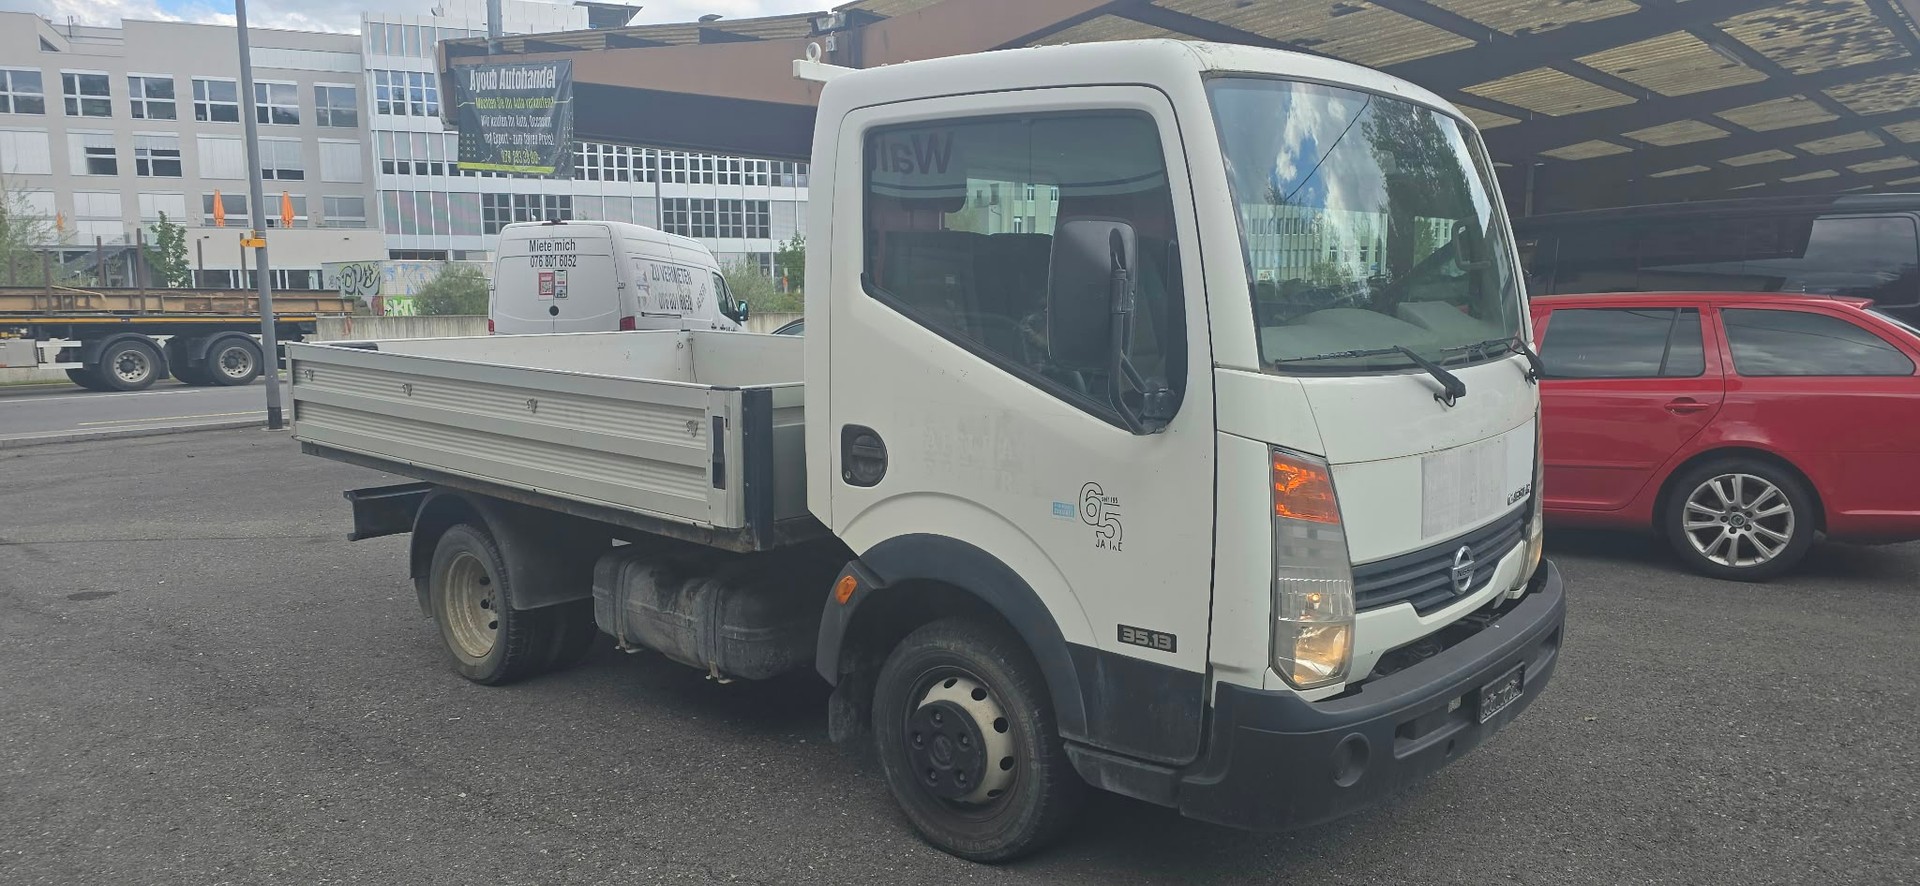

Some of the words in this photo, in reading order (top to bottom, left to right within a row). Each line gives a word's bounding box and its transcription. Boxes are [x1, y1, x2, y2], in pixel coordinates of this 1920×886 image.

[469, 69, 497, 93] Ayoub
[499, 66, 556, 90] Autohandel
[529, 240, 552, 252] Miete
[554, 239, 576, 252] mich
[530, 255, 543, 268] 076
[545, 255, 557, 267] 801
[559, 254, 577, 267] 6052
[1079, 482, 1122, 542] 65
[1122, 627, 1172, 650] 35.13
